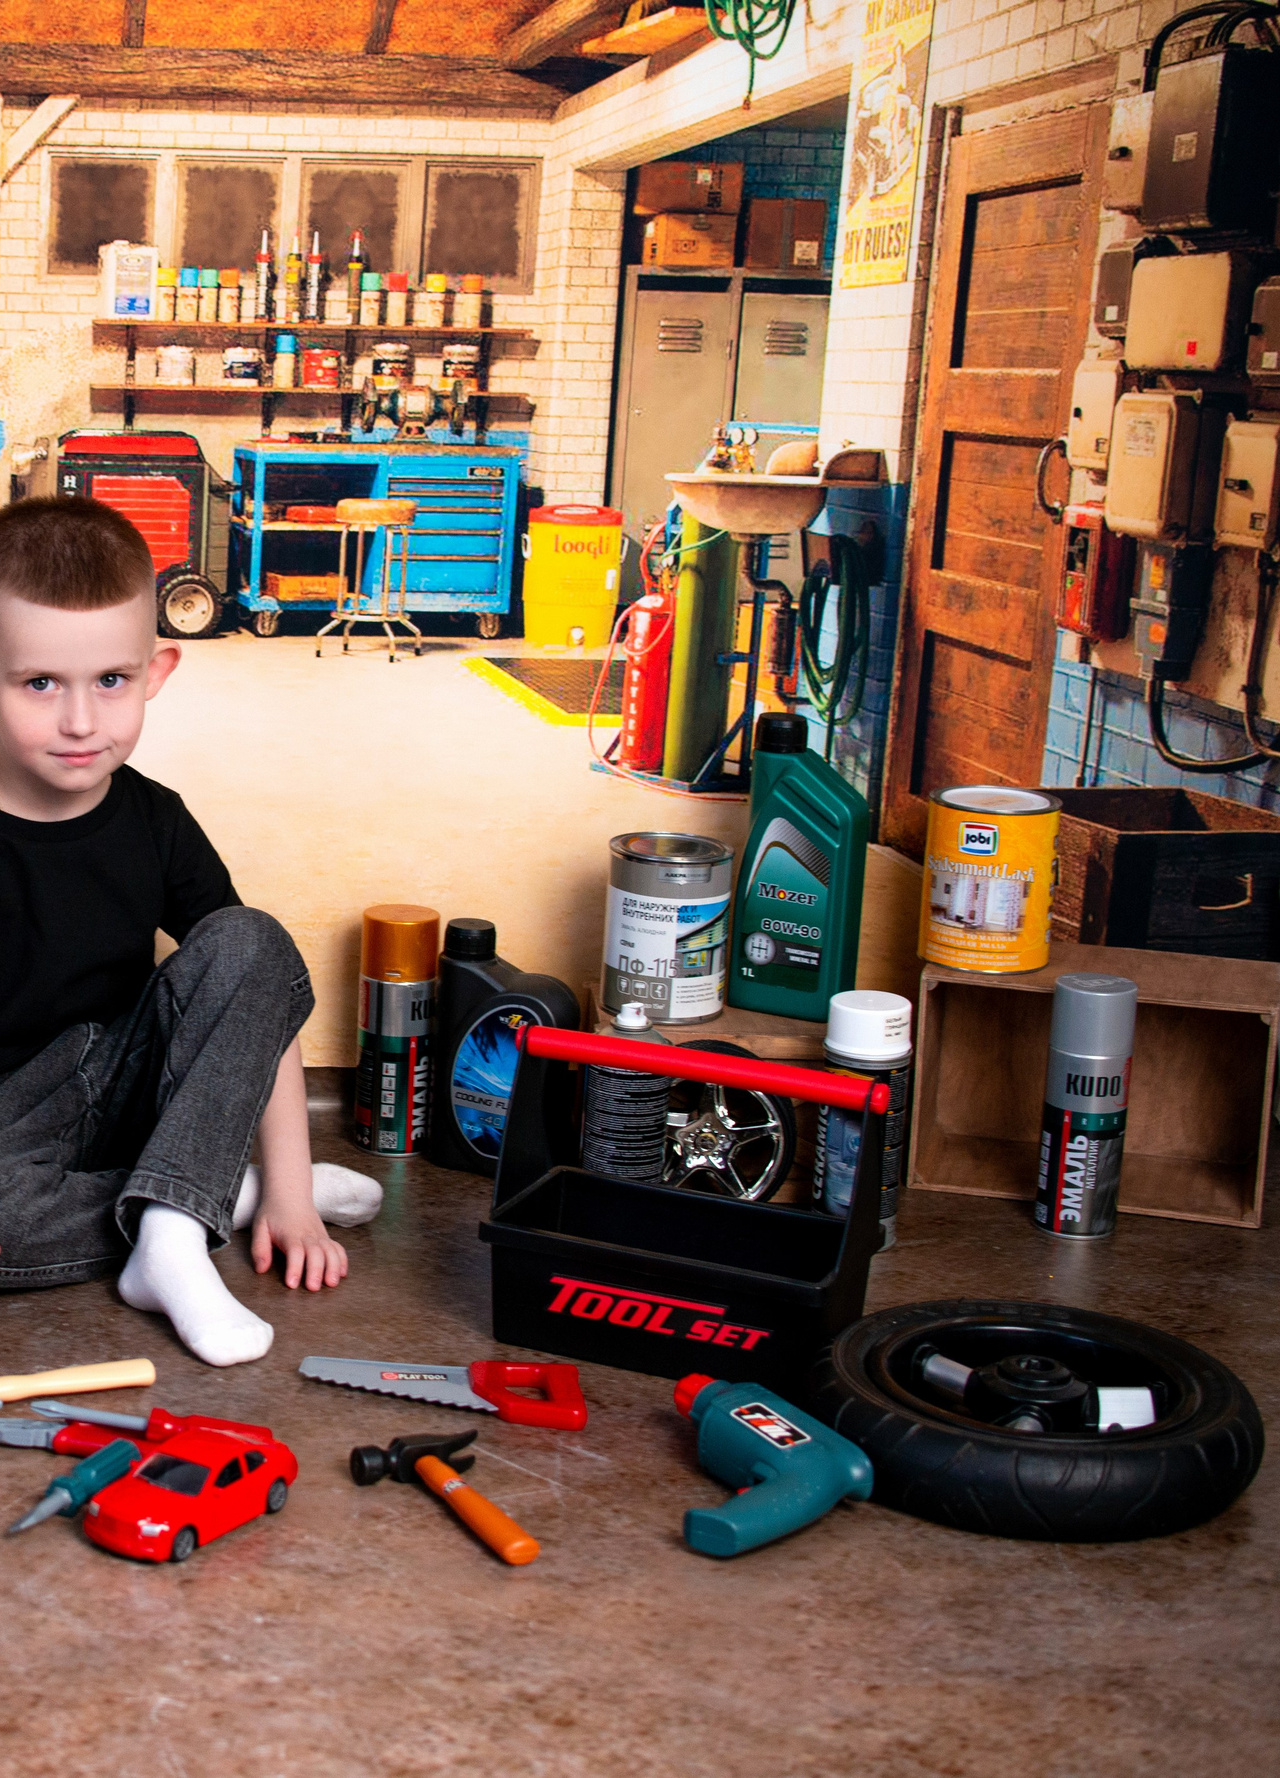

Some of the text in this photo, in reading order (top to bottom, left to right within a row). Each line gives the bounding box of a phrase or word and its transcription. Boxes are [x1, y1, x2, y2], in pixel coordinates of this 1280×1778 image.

[864, 221, 908, 262] RULES!
[622, 897, 638, 909] ДЛЯ
[639, 900, 689, 913] НАРУЖНЫХ
[758, 882, 819, 906] Mozer
[622, 908, 701, 923] ВНУТРЕННИХ РАБОТ
[762, 919, 821, 939] 80W-90
[619, 954, 679, 979] ПФ-115
[741, 967, 755, 977] 1L
[411, 1000, 436, 1021] KU
[1065, 1073, 1121, 1098] KUDO
[411, 1056, 430, 1141] ЭМАЛЬ
[455, 1091, 492, 1107] COOLING
[1085, 1139, 1100, 1190] МЕТАЛЛИК
[1059, 1135, 1089, 1223] ЭМАЛЬ
[547, 1275, 770, 1350] TOOL SET
